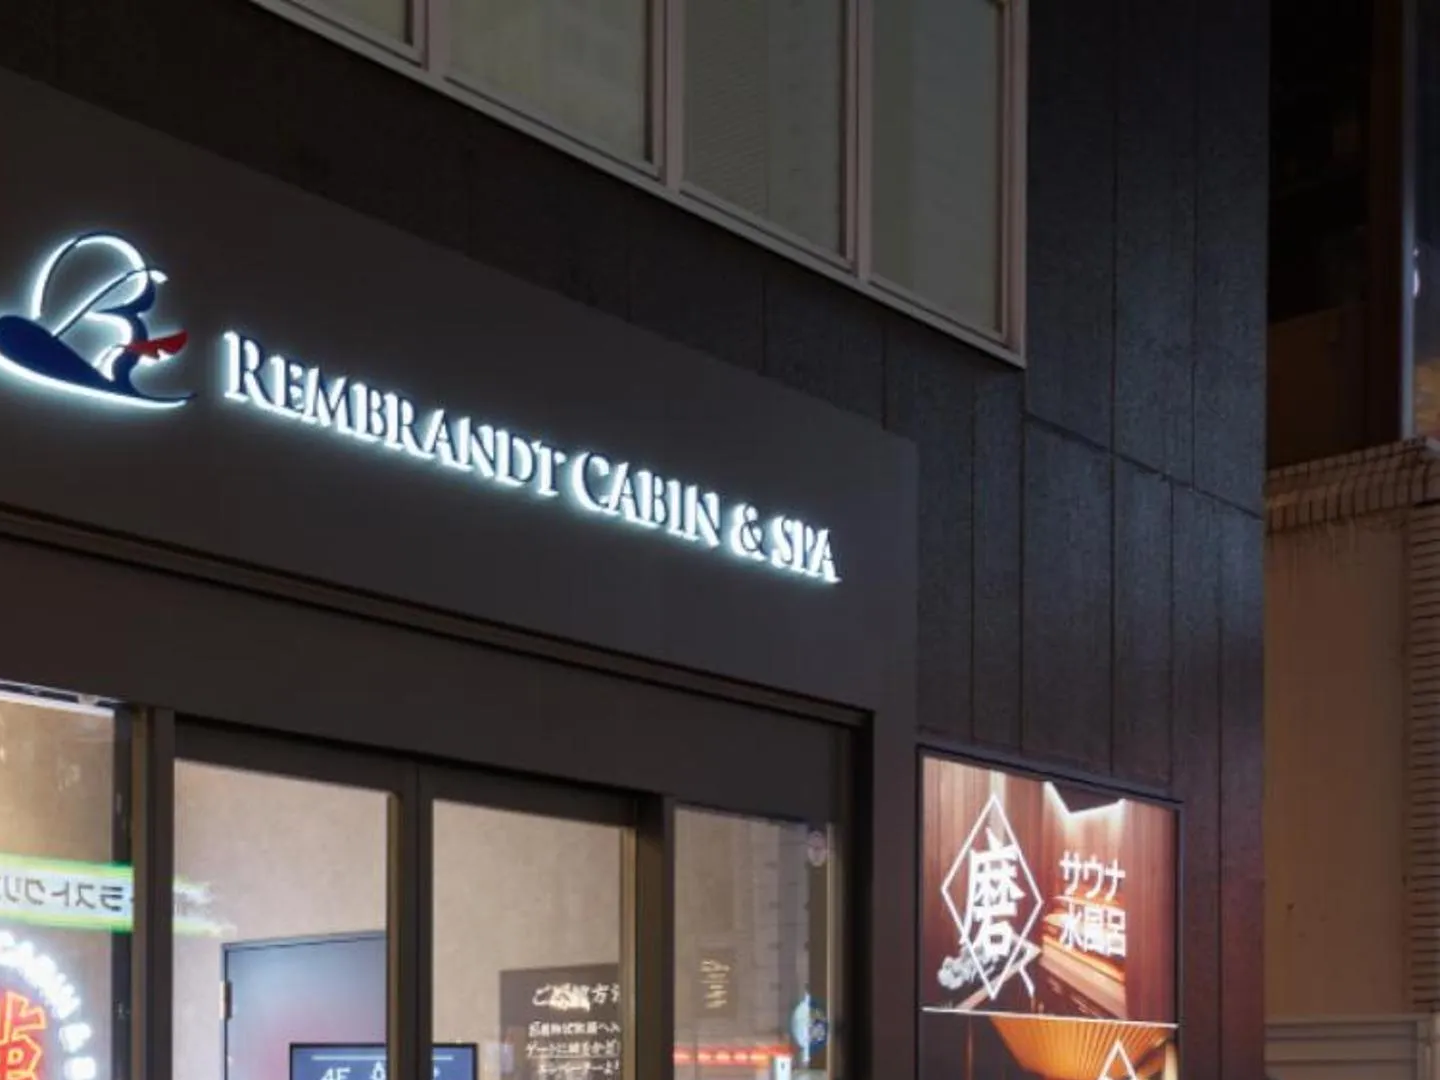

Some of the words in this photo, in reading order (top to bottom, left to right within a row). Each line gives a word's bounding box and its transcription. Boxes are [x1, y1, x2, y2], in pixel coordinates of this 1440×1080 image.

[223, 330, 566, 496] REMBRANDT
[568, 452, 719, 550] CABIN
[729, 503, 764, 561] &
[768, 512, 840, 584] SPA
[1059, 852, 1127, 902] サウナ
